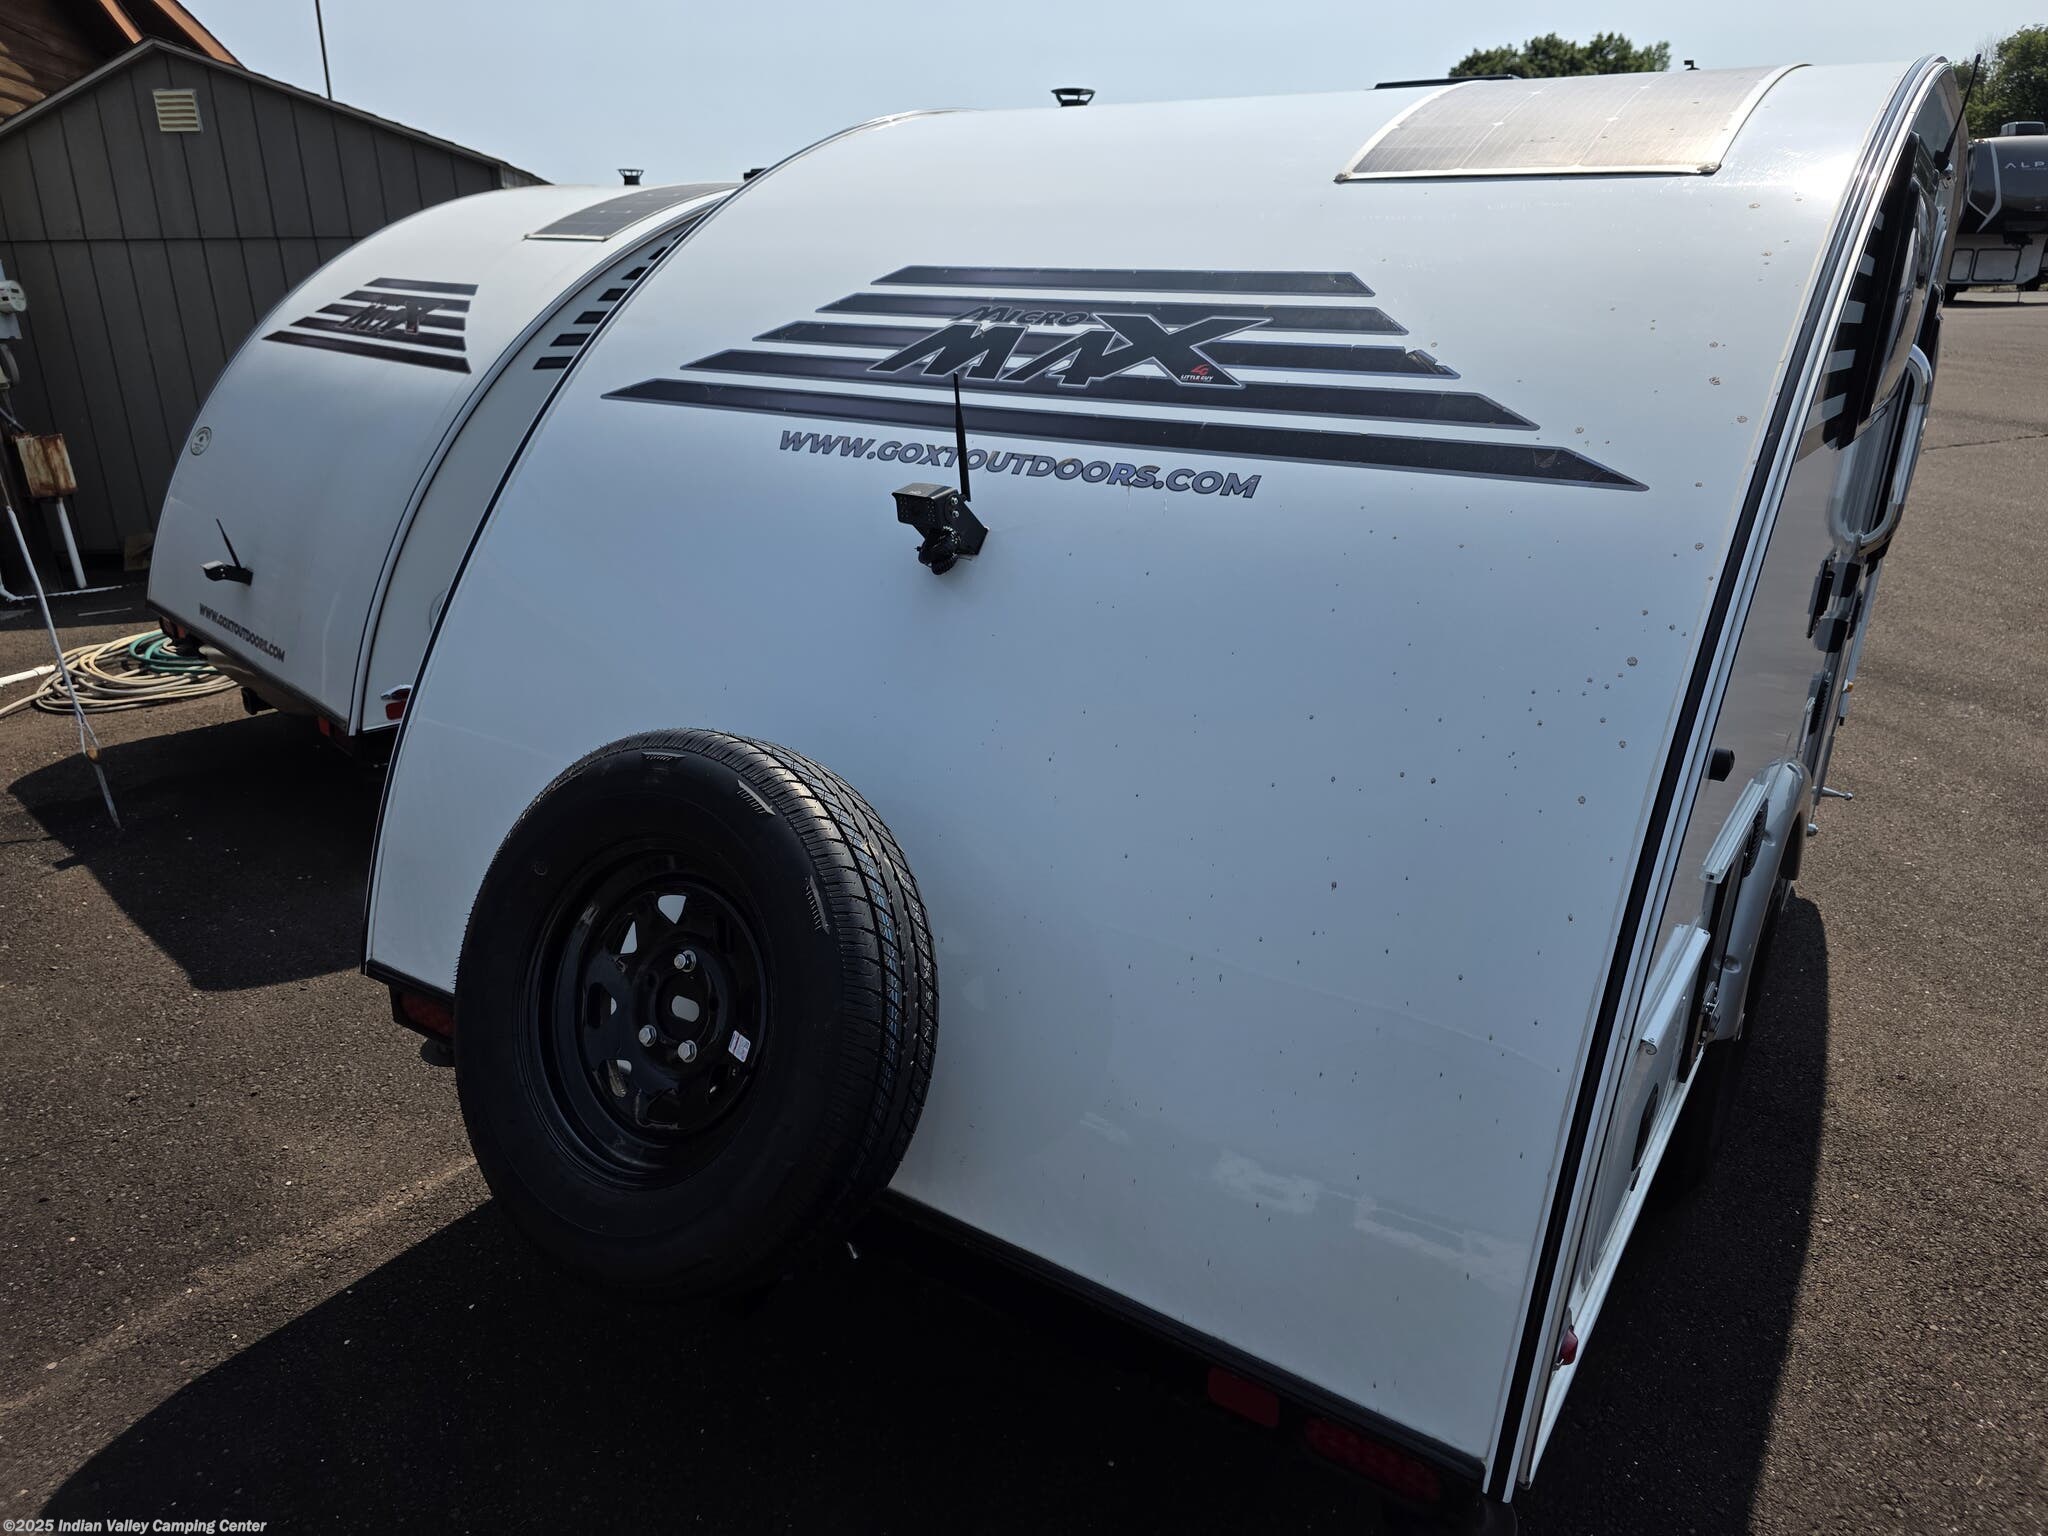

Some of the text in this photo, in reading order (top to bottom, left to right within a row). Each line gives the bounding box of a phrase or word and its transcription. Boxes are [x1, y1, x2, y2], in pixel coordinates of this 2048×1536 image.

[950, 305, 1089, 327] MICRO
[866, 313, 1272, 389] MAX
[779, 430, 1262, 499] WWW.GOXTOUTDOORS.COM
